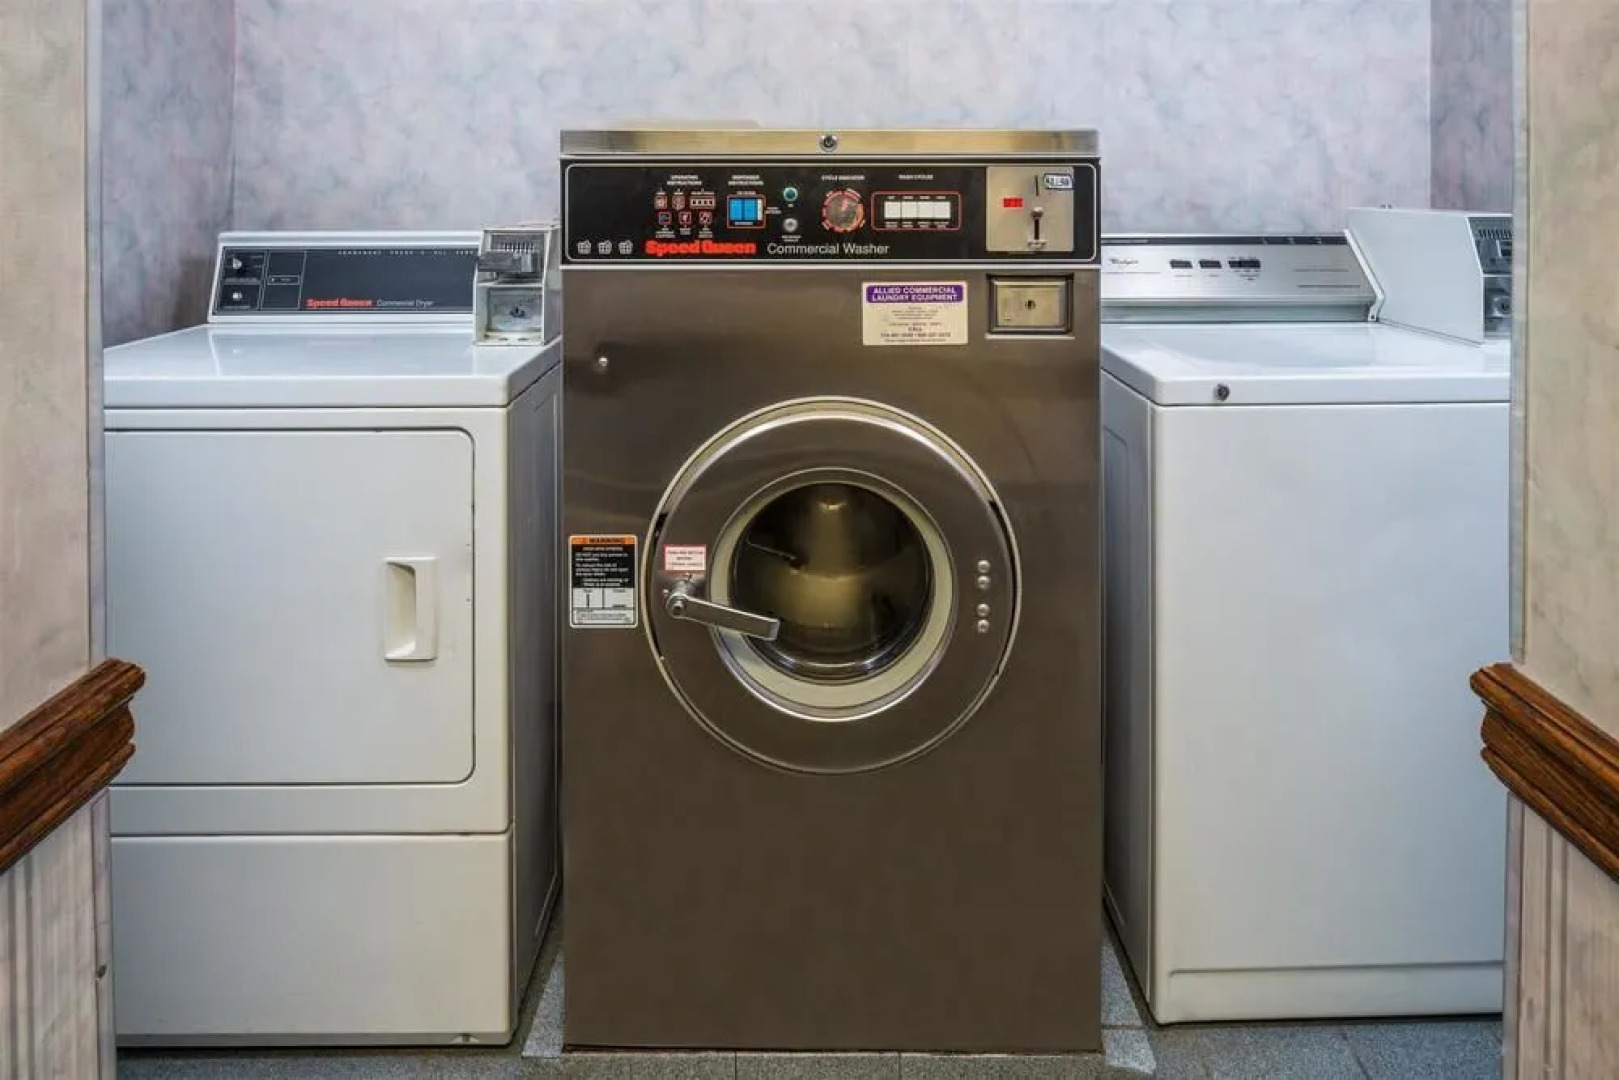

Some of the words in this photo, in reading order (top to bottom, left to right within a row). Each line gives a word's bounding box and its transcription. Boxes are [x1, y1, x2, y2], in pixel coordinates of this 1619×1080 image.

[645, 240, 701, 257] Speed
[702, 240, 757, 254] Queen
[766, 242, 839, 255] Commercial
[841, 242, 890, 255] Washer
[873, 286, 901, 294] ALLIED
[903, 286, 956, 294] COMMERCIAL
[307, 298, 339, 309] Speed
[339, 297, 373, 307] Queen
[376, 298, 415, 307] Commercial
[415, 298, 435, 309] Dryer
[872, 294, 909, 302] LAUNDRY
[910, 294, 958, 302] EQUIPMENT
